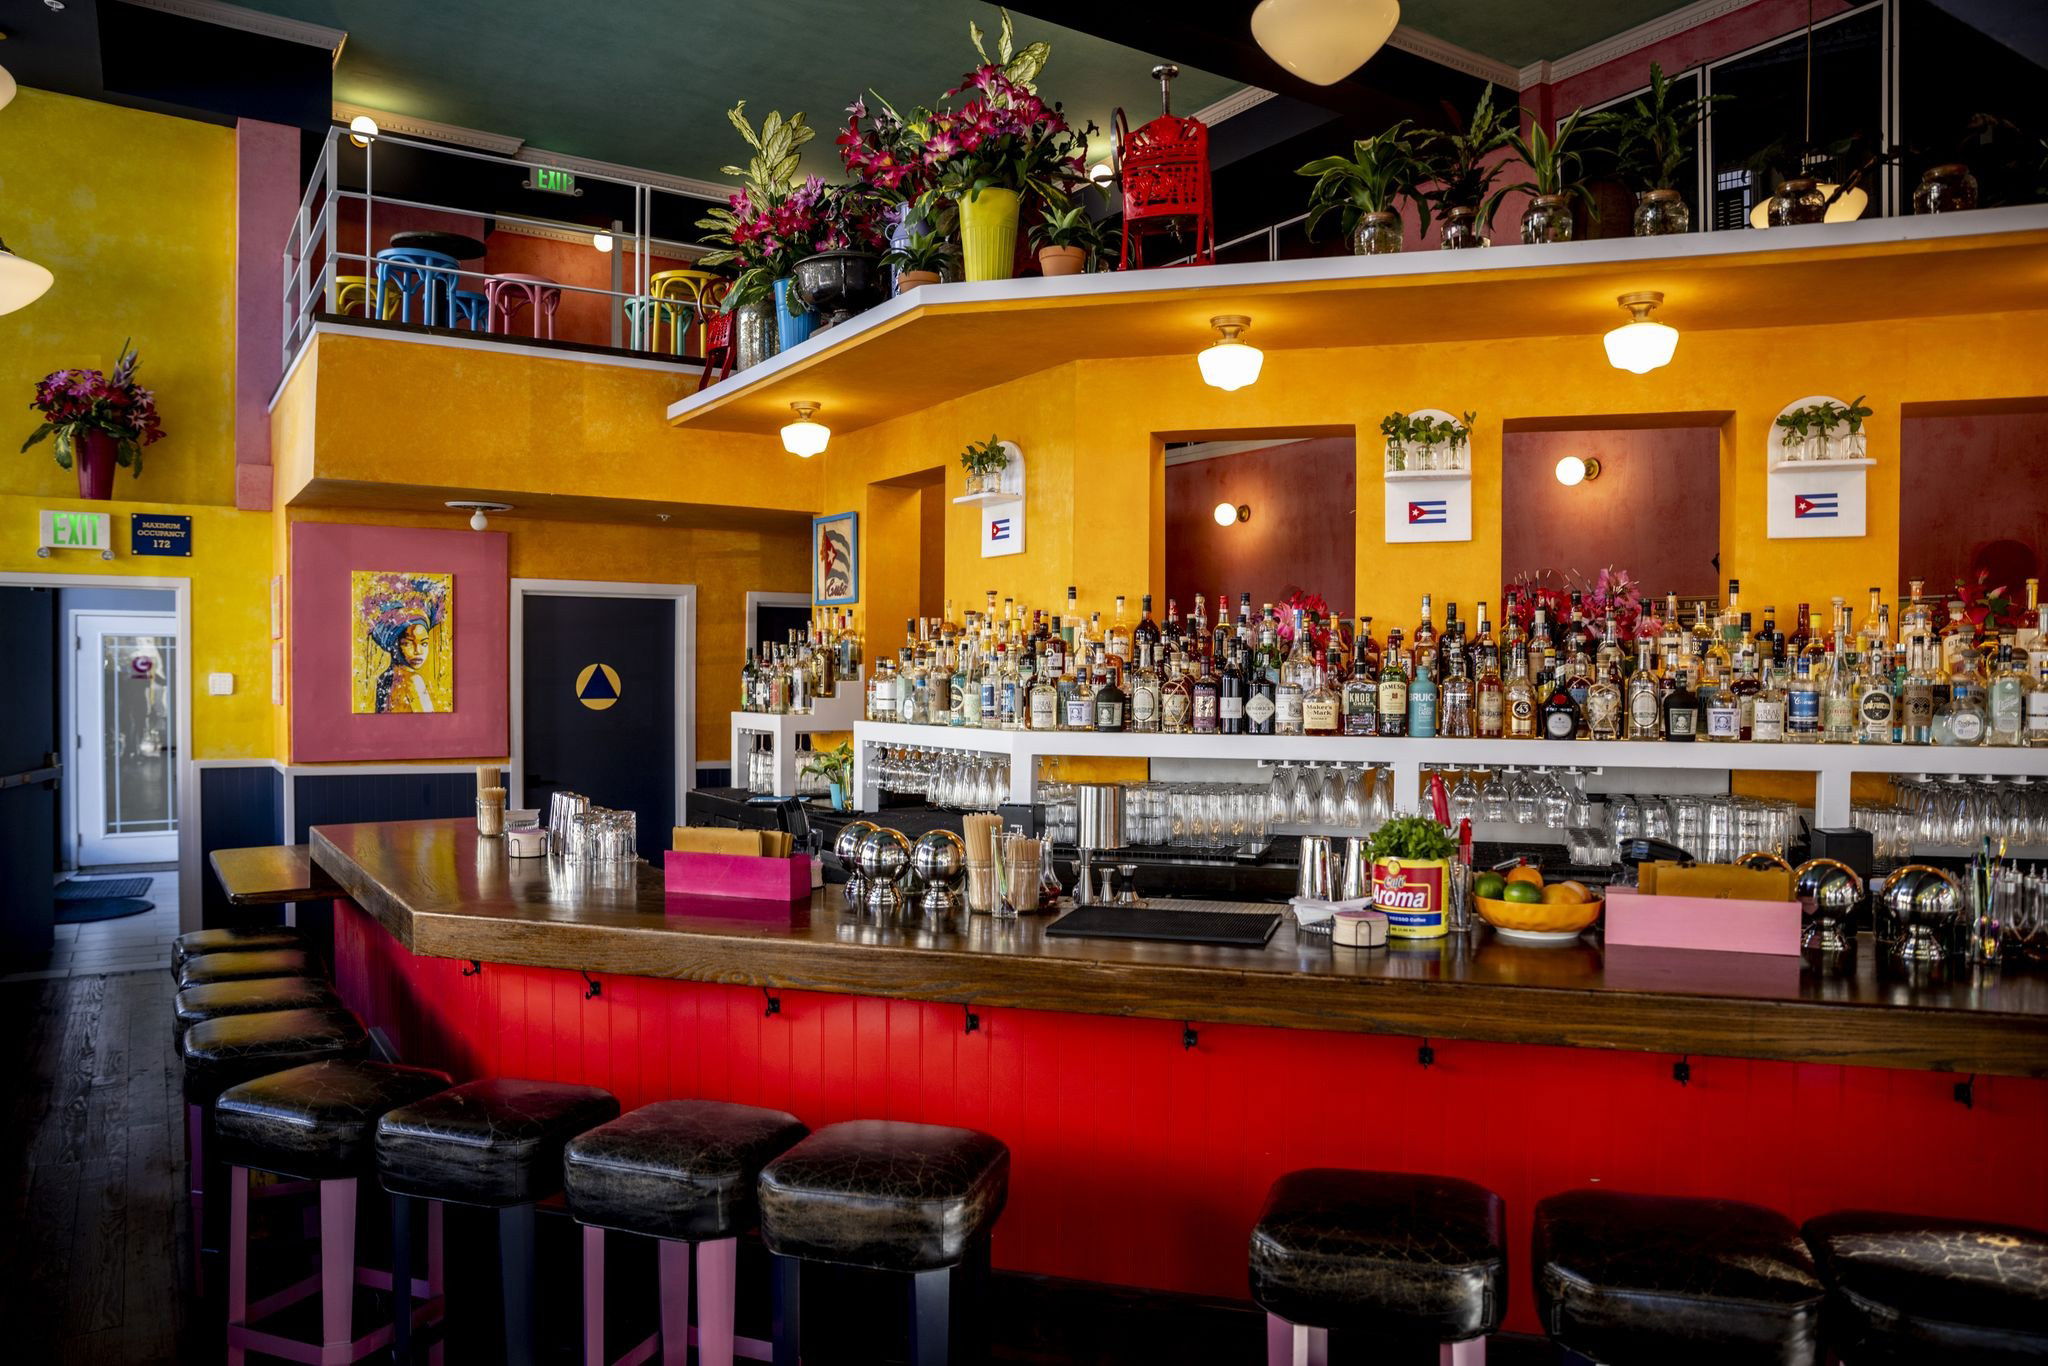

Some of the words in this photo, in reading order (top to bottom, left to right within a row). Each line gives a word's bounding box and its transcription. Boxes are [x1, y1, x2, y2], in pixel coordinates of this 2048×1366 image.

[538, 168, 568, 192] EXIT
[52, 512, 101, 546] EXIT
[142, 522, 181, 530] MAXIMUM
[137, 530, 186, 538] OCCUPANCY
[153, 540, 171, 549] 172
[827, 579, 848, 597] Cuba
[1349, 692, 1370, 703] KNOB
[1409, 693, 1436, 702] BRUIC
[1516, 704, 1529, 714] 43
[1384, 875, 1407, 889] Café
[1373, 884, 1426, 908] Aroma
